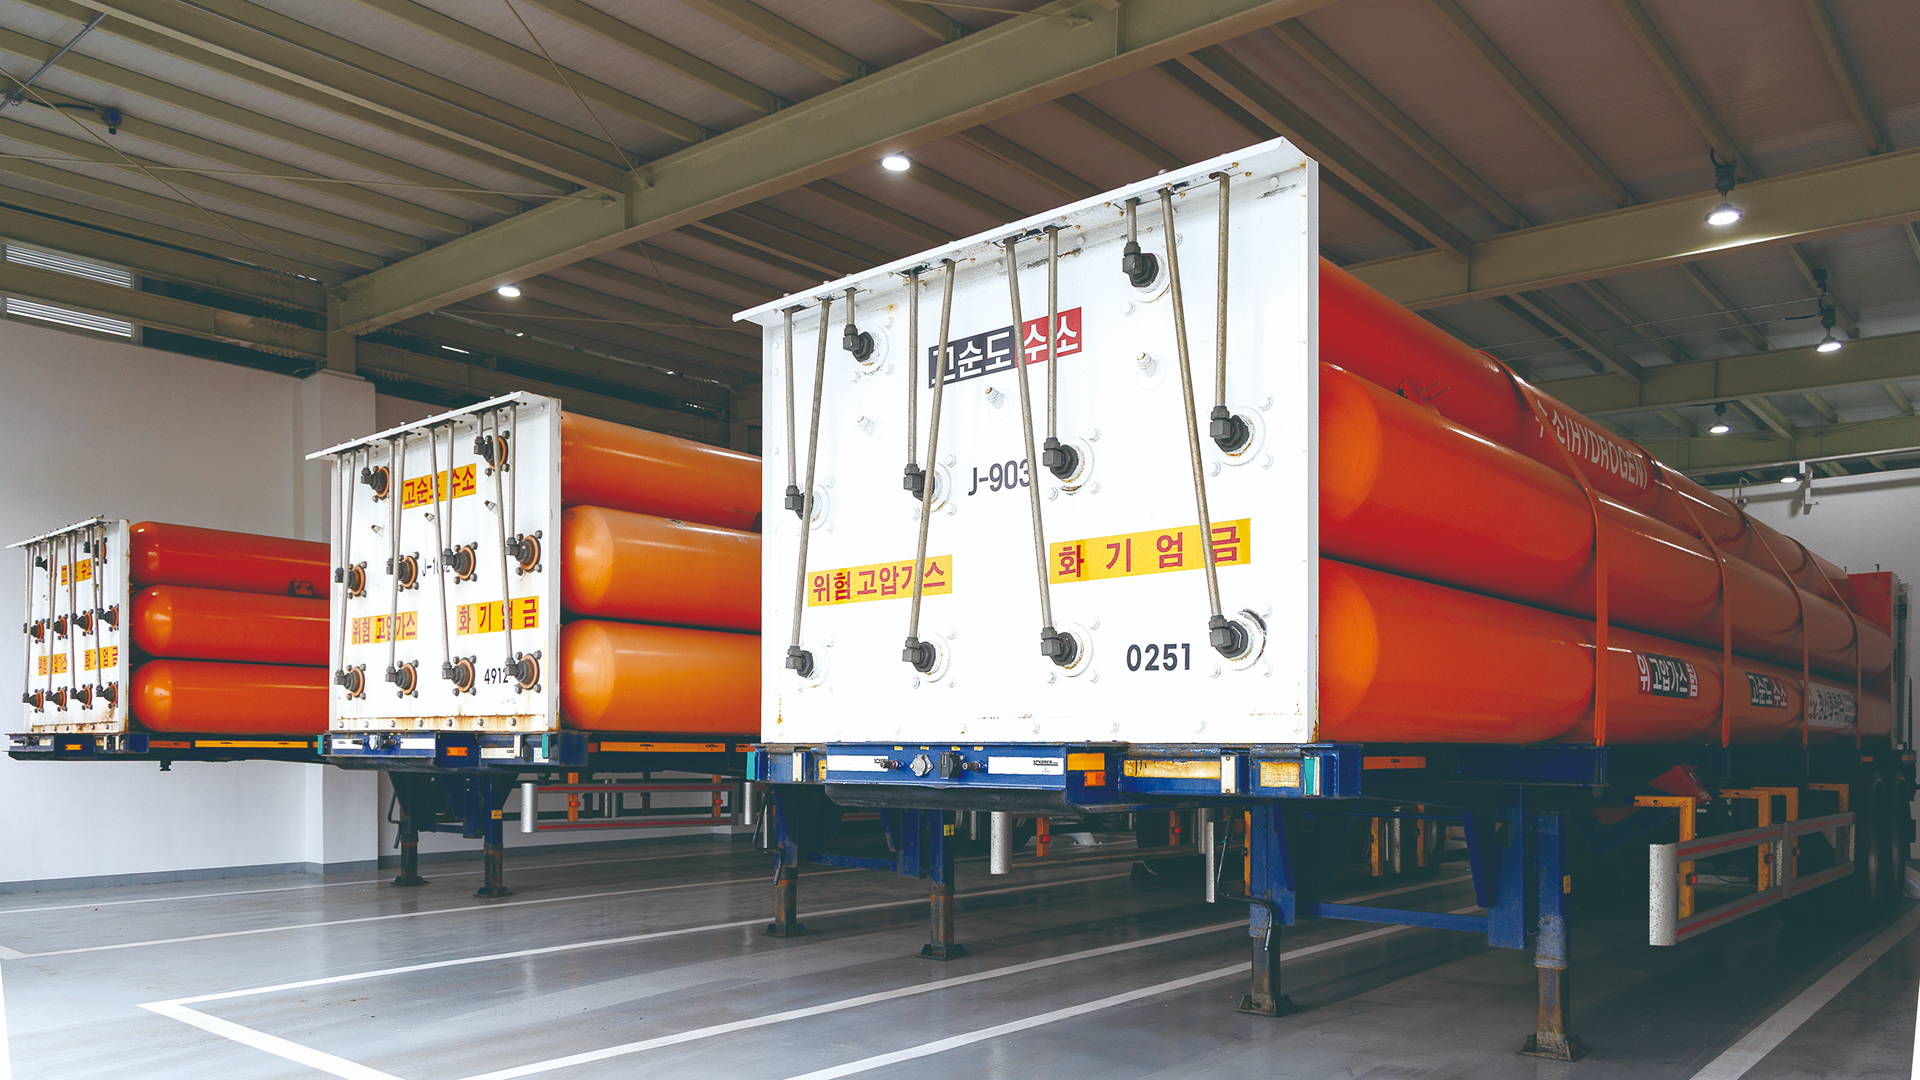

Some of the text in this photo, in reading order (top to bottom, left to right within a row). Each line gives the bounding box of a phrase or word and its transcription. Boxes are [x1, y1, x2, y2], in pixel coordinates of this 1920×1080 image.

[931, 316, 1079, 385] 고순도 수소
[813, 570, 851, 602] 위험
[1125, 642, 1193, 673] 0251
[484, 667, 509, 685] 4912
